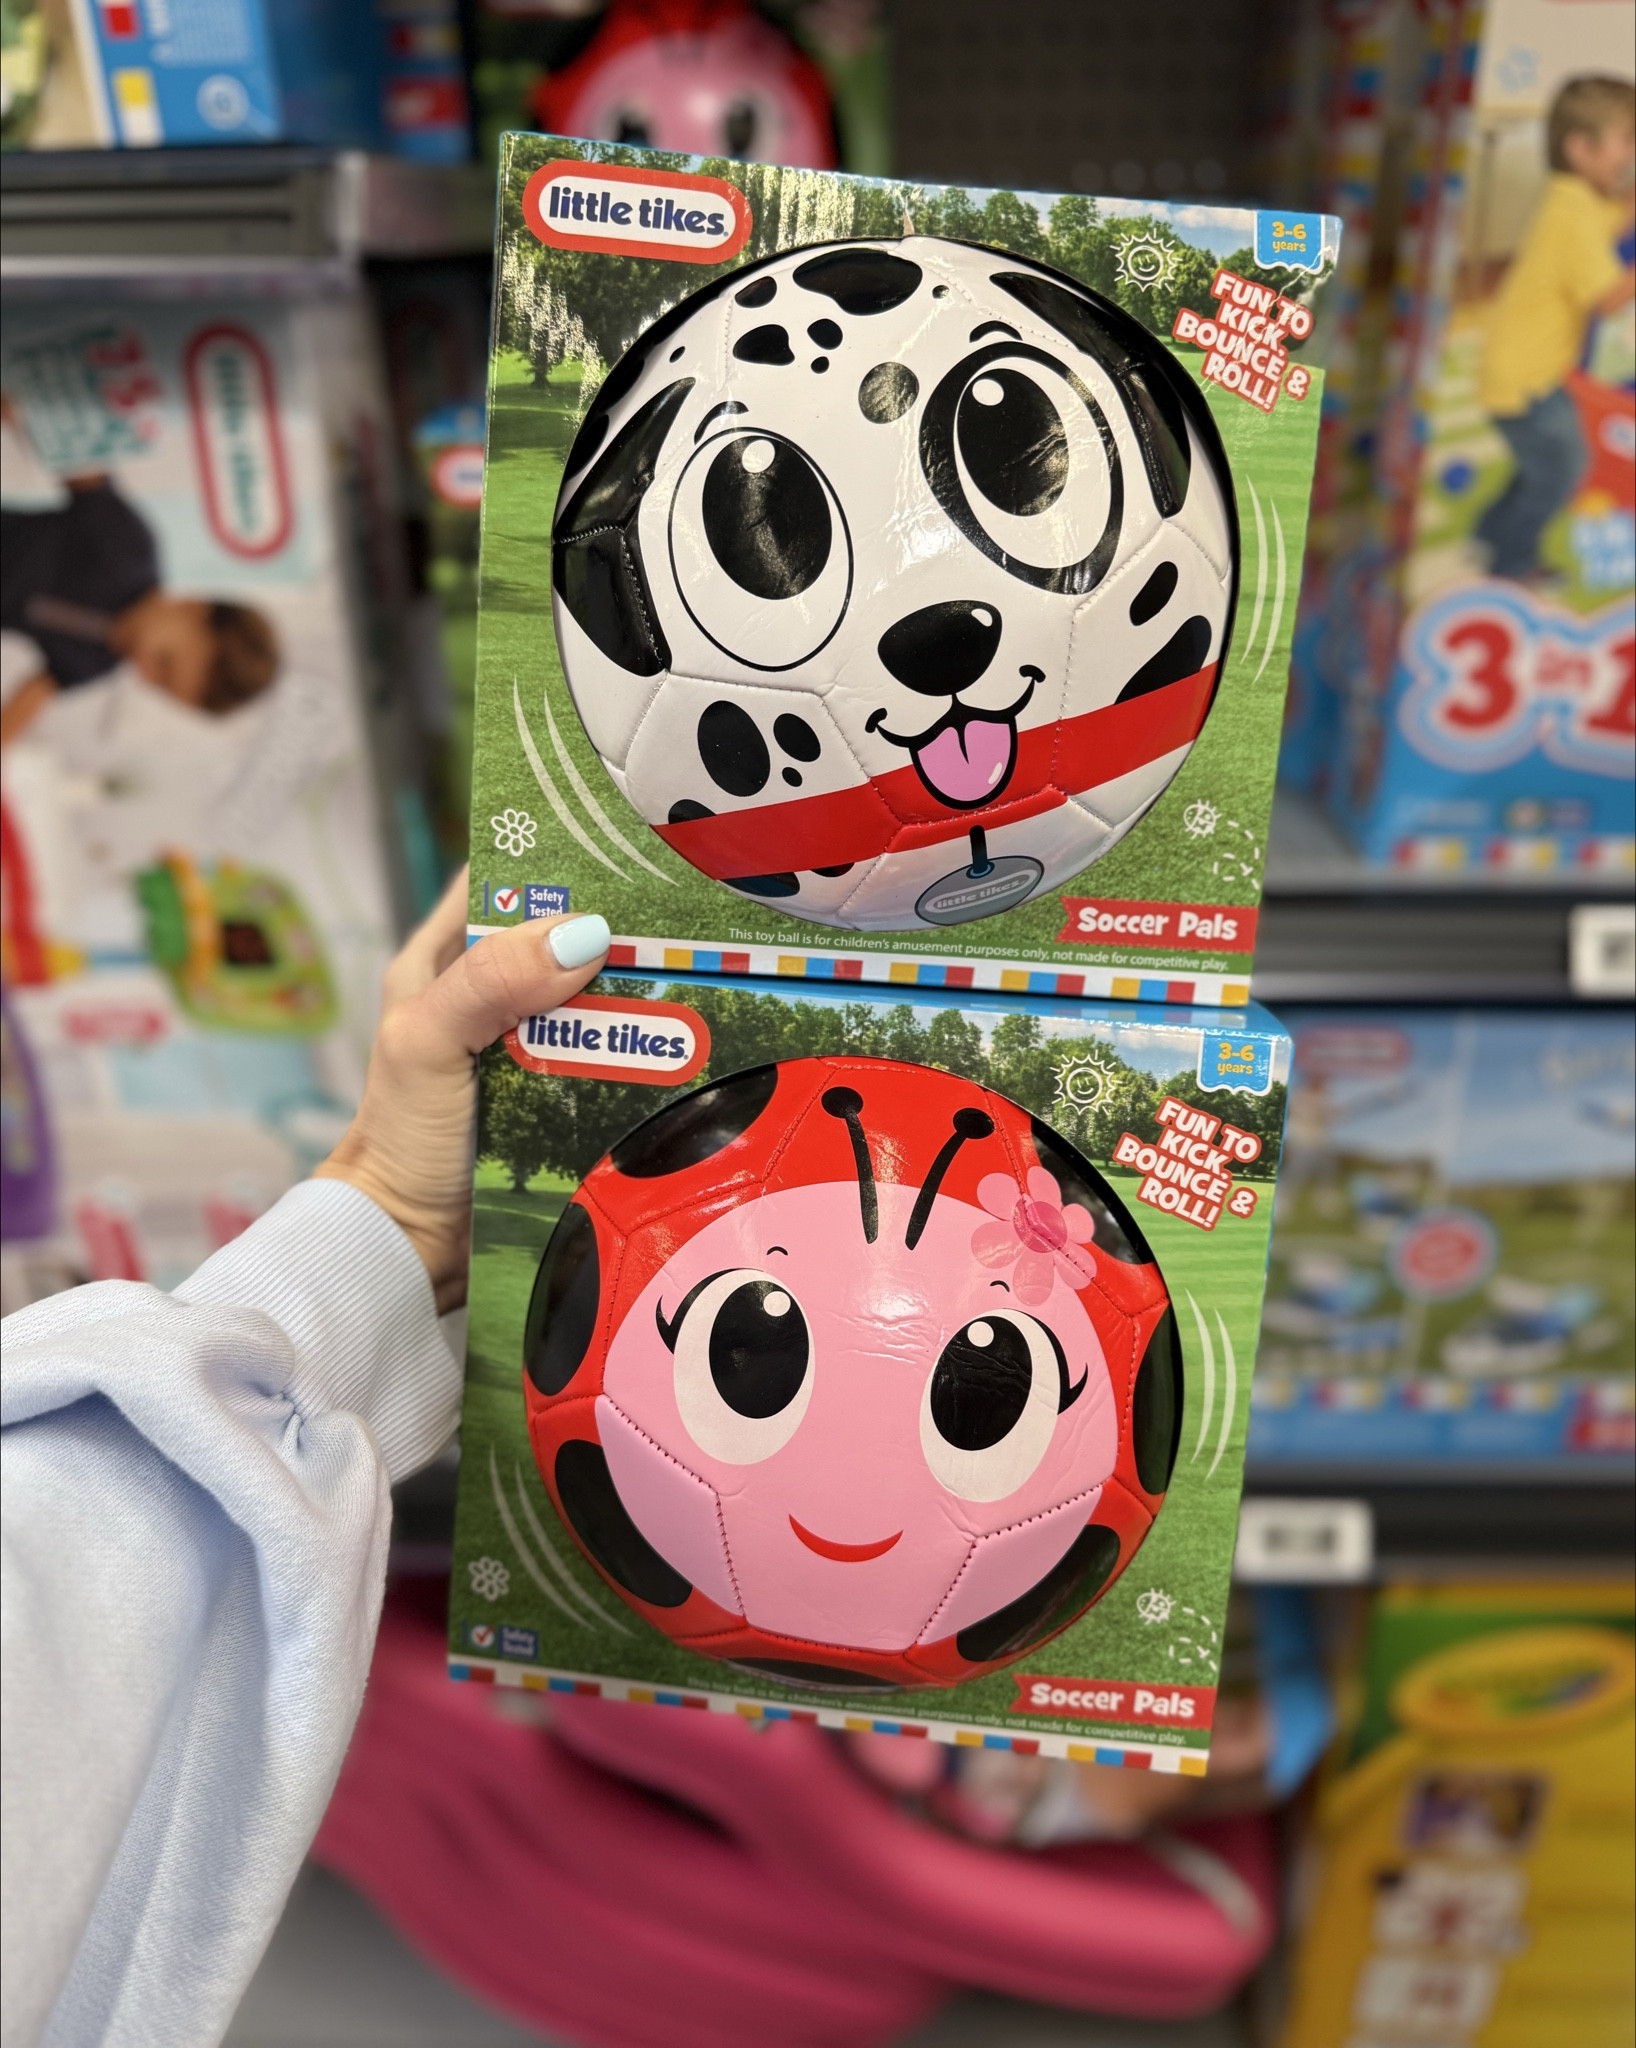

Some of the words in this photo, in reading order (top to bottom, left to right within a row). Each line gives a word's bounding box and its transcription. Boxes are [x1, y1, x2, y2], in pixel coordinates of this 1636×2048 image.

[549, 186, 633, 226] little
[639, 197, 726, 236] tikes
[1272, 221, 1306, 240] 3-6
[1272, 240, 1306, 253] years
[1213, 272, 1274, 314] FUN
[1278, 300, 1311, 335] TO
[1219, 304, 1286, 357] KICK,
[1176, 312, 1285, 382] BOUNCE
[1286, 369, 1308, 398] &
[1205, 352, 1277, 410] ROLL!
[1442, 618, 1518, 729] 3
[529, 888, 564, 905] Safety
[529, 904, 563, 916] Tested
[937, 895, 977, 909] little
[980, 880, 1020, 898] tikes
[1077, 906, 1170, 936] Soccer
[1177, 911, 1238, 940] Pals
[728, 928, 752, 940] This
[756, 931, 775, 944] toy
[778, 931, 799, 943] ball
[802, 933, 812, 944] is
[814, 934, 830, 945] for
[834, 936, 890, 949] children's
[892, 941, 963, 953] amusement
[965, 944, 1020, 957] purposes
[1022, 947, 1050, 960] only,
[1052, 951, 1073, 961] not
[1076, 951, 1109, 963] made
[1112, 952, 1128, 964] for
[1130, 954, 1200, 968] competitive
[1201, 958, 1229, 972] play.
[527, 1015, 602, 1050] little
[607, 1024, 686, 1059] tikes
[1218, 1042, 1254, 1062] 3-6
[1217, 1062, 1253, 1076] years
[1158, 1100, 1217, 1141] FUN
[1222, 1128, 1258, 1160] TO
[1116, 1137, 1228, 1202] BOUNCE
[1230, 1190, 1254, 1215] &
[1160, 1130, 1229, 1179] KICK,
[1140, 1178, 1219, 1228] ROLL!
[1030, 1682, 1124, 1711] Soccer
[1133, 1689, 1195, 1718] Pals
[845, 1702, 915, 1717] amusement
[918, 1708, 973, 1722] purposes
[975, 1714, 1003, 1726] only,
[1006, 1717, 1027, 1728] not
[1029, 1721, 1063, 1732] made
[1066, 1721, 1083, 1733] for
[1084, 1726, 1157, 1741] competitive
[1158, 1732, 1187, 1745] play.
